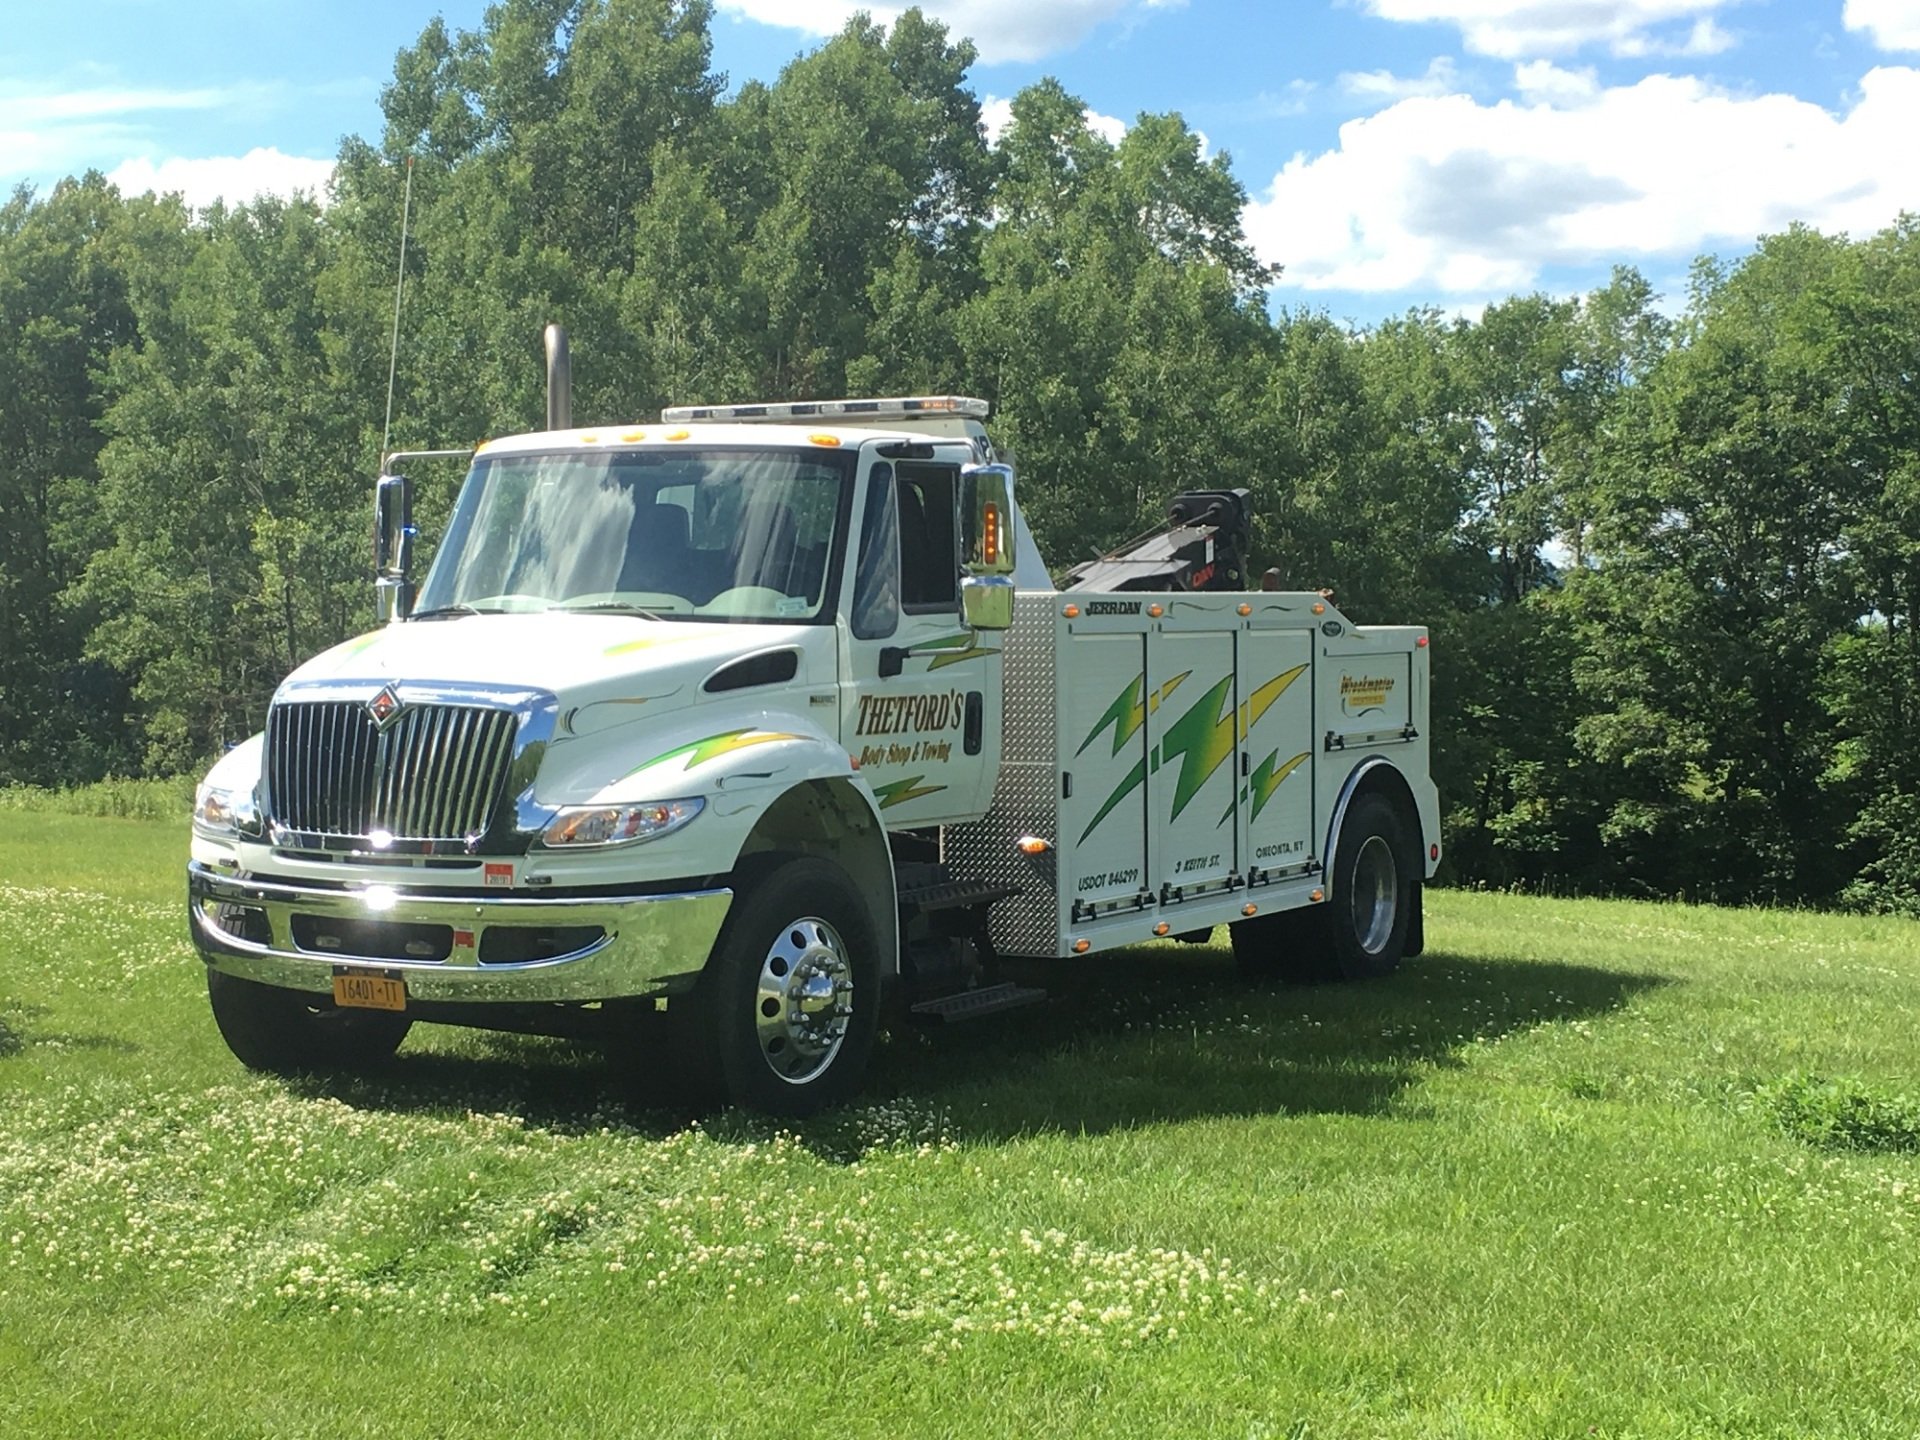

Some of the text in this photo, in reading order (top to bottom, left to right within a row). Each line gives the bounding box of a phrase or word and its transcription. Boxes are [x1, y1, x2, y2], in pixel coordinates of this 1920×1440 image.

[855, 688, 964, 736] THETFORD'S
[860, 743, 884, 768] Body
[886, 742, 912, 767] Shop
[921, 739, 953, 763] Towing
[1174, 861, 1182, 874] 3
[1183, 856, 1208, 872] KEITH
[1078, 868, 1138, 891] USDOT 846299
